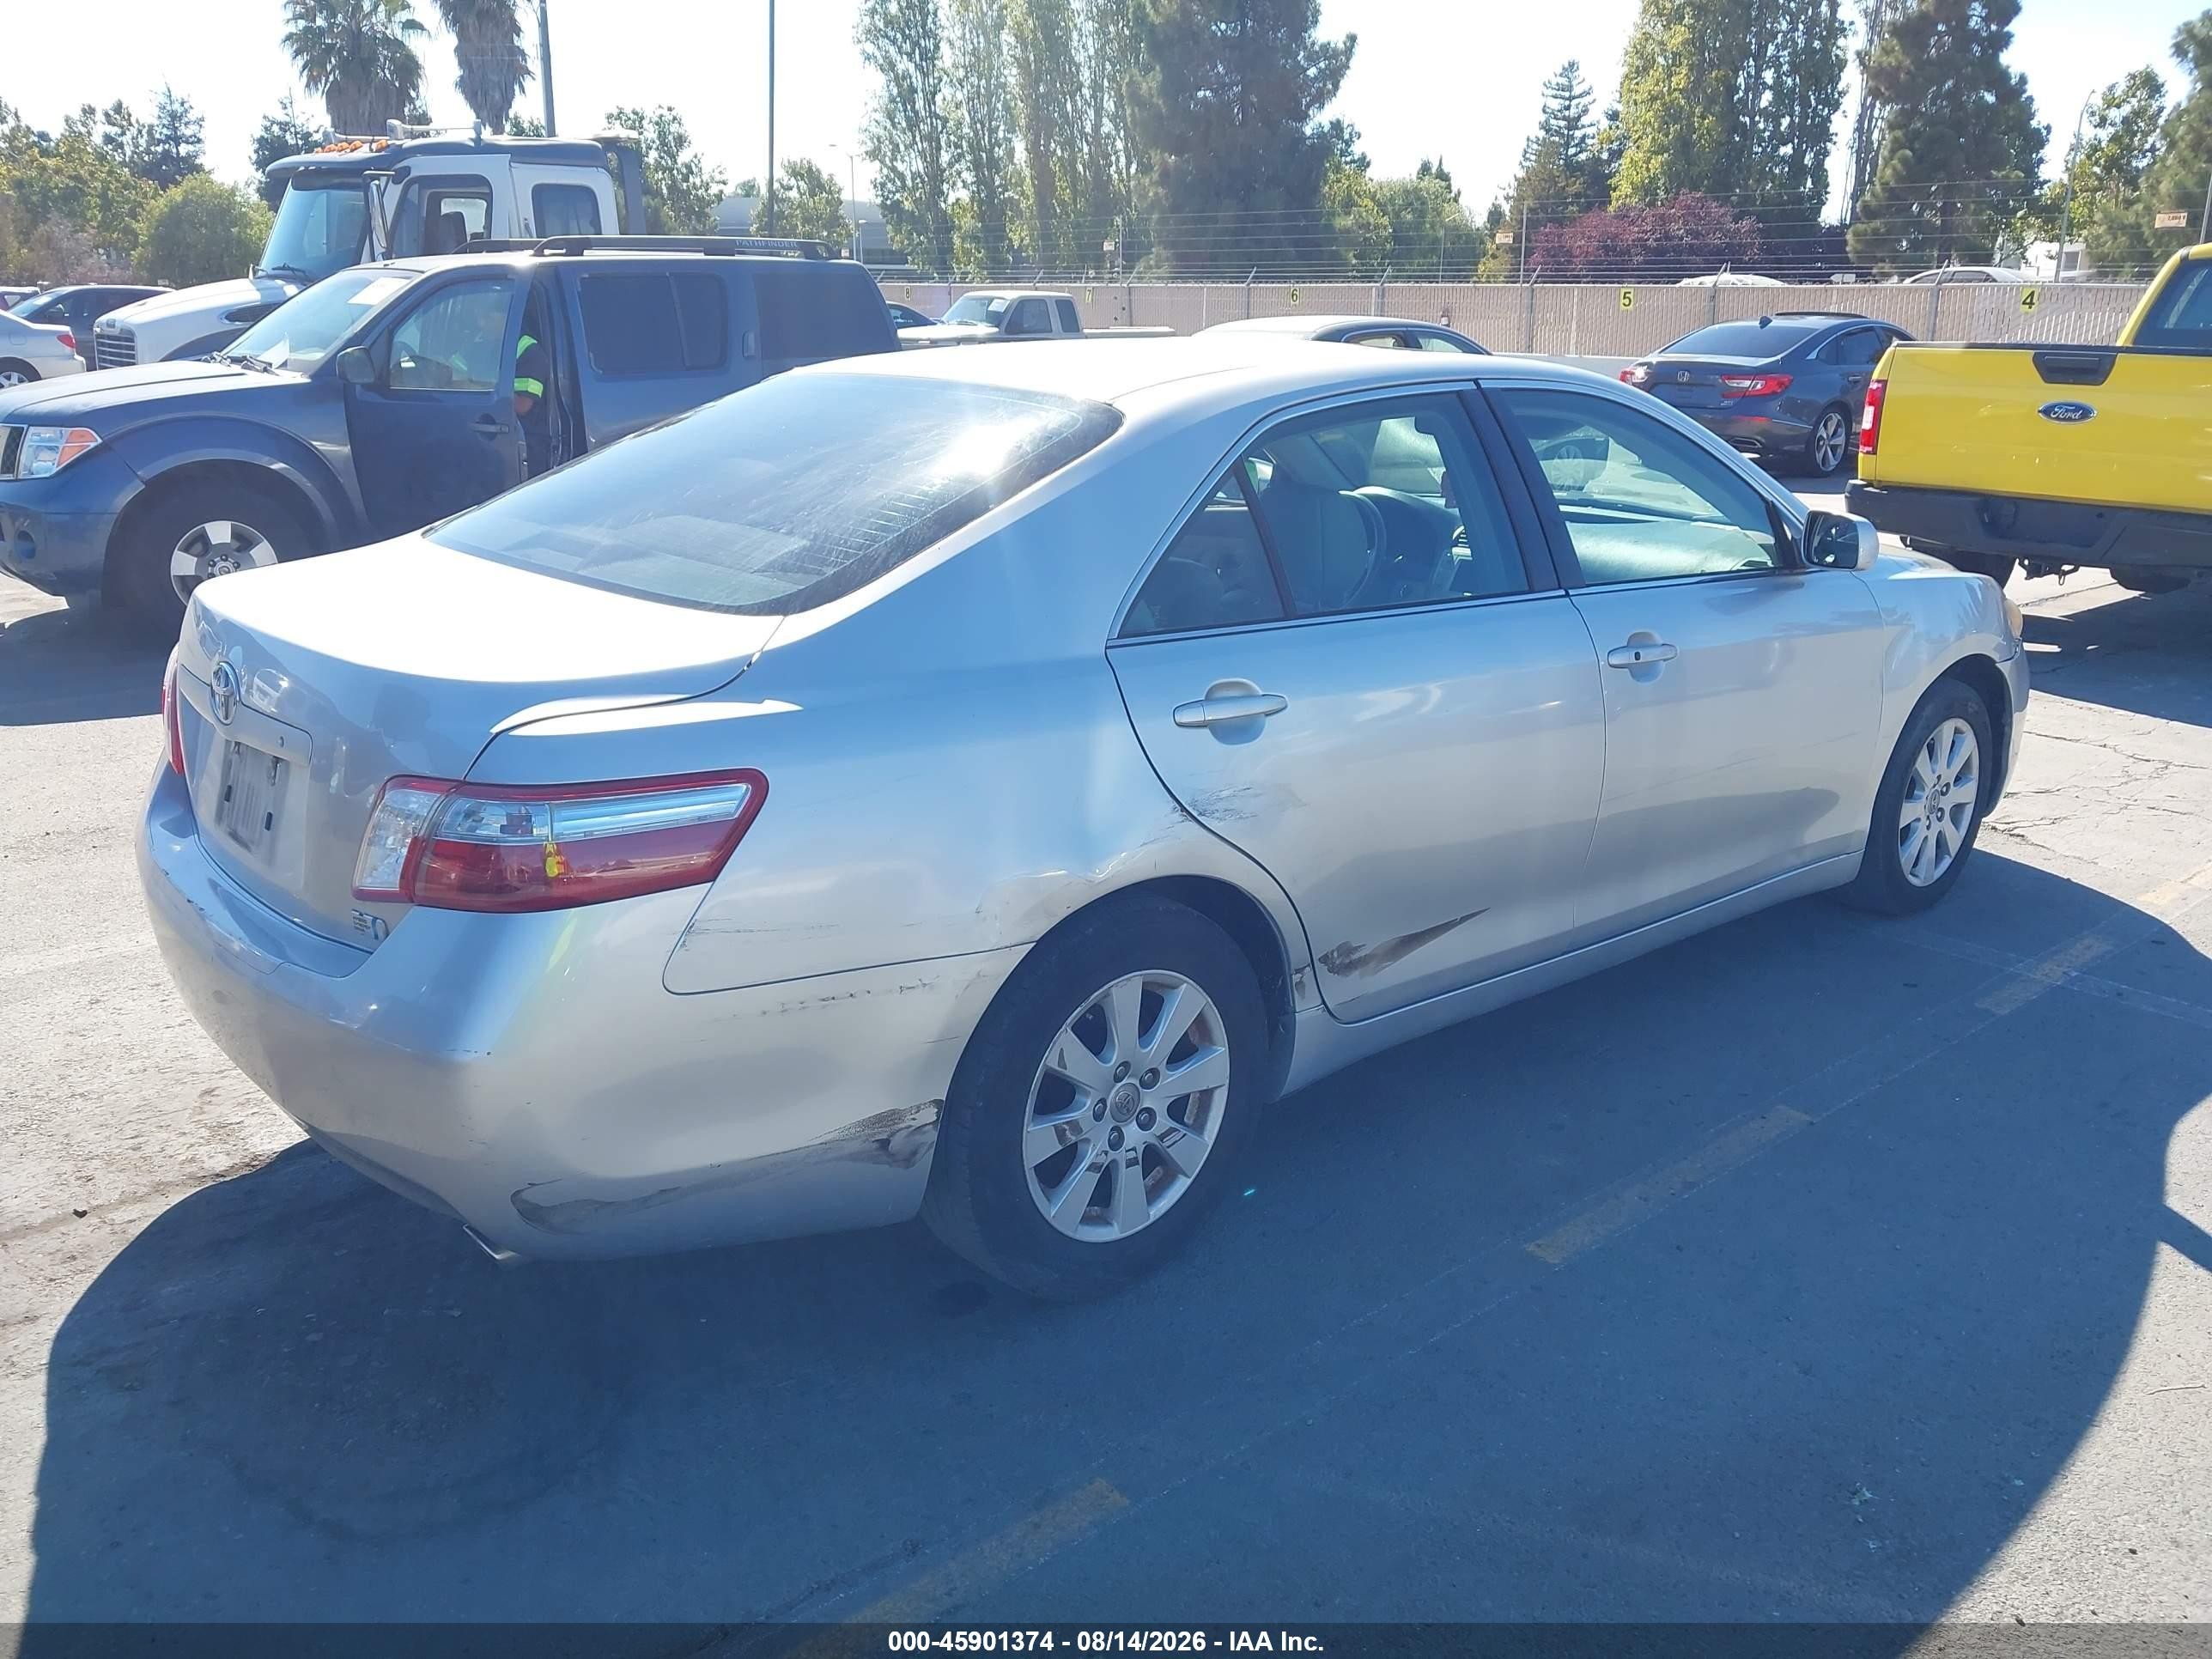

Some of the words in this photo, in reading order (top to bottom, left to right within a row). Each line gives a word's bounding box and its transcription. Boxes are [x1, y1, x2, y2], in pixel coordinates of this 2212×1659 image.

[735, 240, 798, 248] PATHFINDER
[906, 288, 910, 299] 8
[1086, 289, 1091, 301] 7
[1291, 289, 1297, 302] 6
[1622, 291, 1632, 307] 5
[2021, 290, 2035, 309] 4
[2050, 404, 2083, 419] Ford
